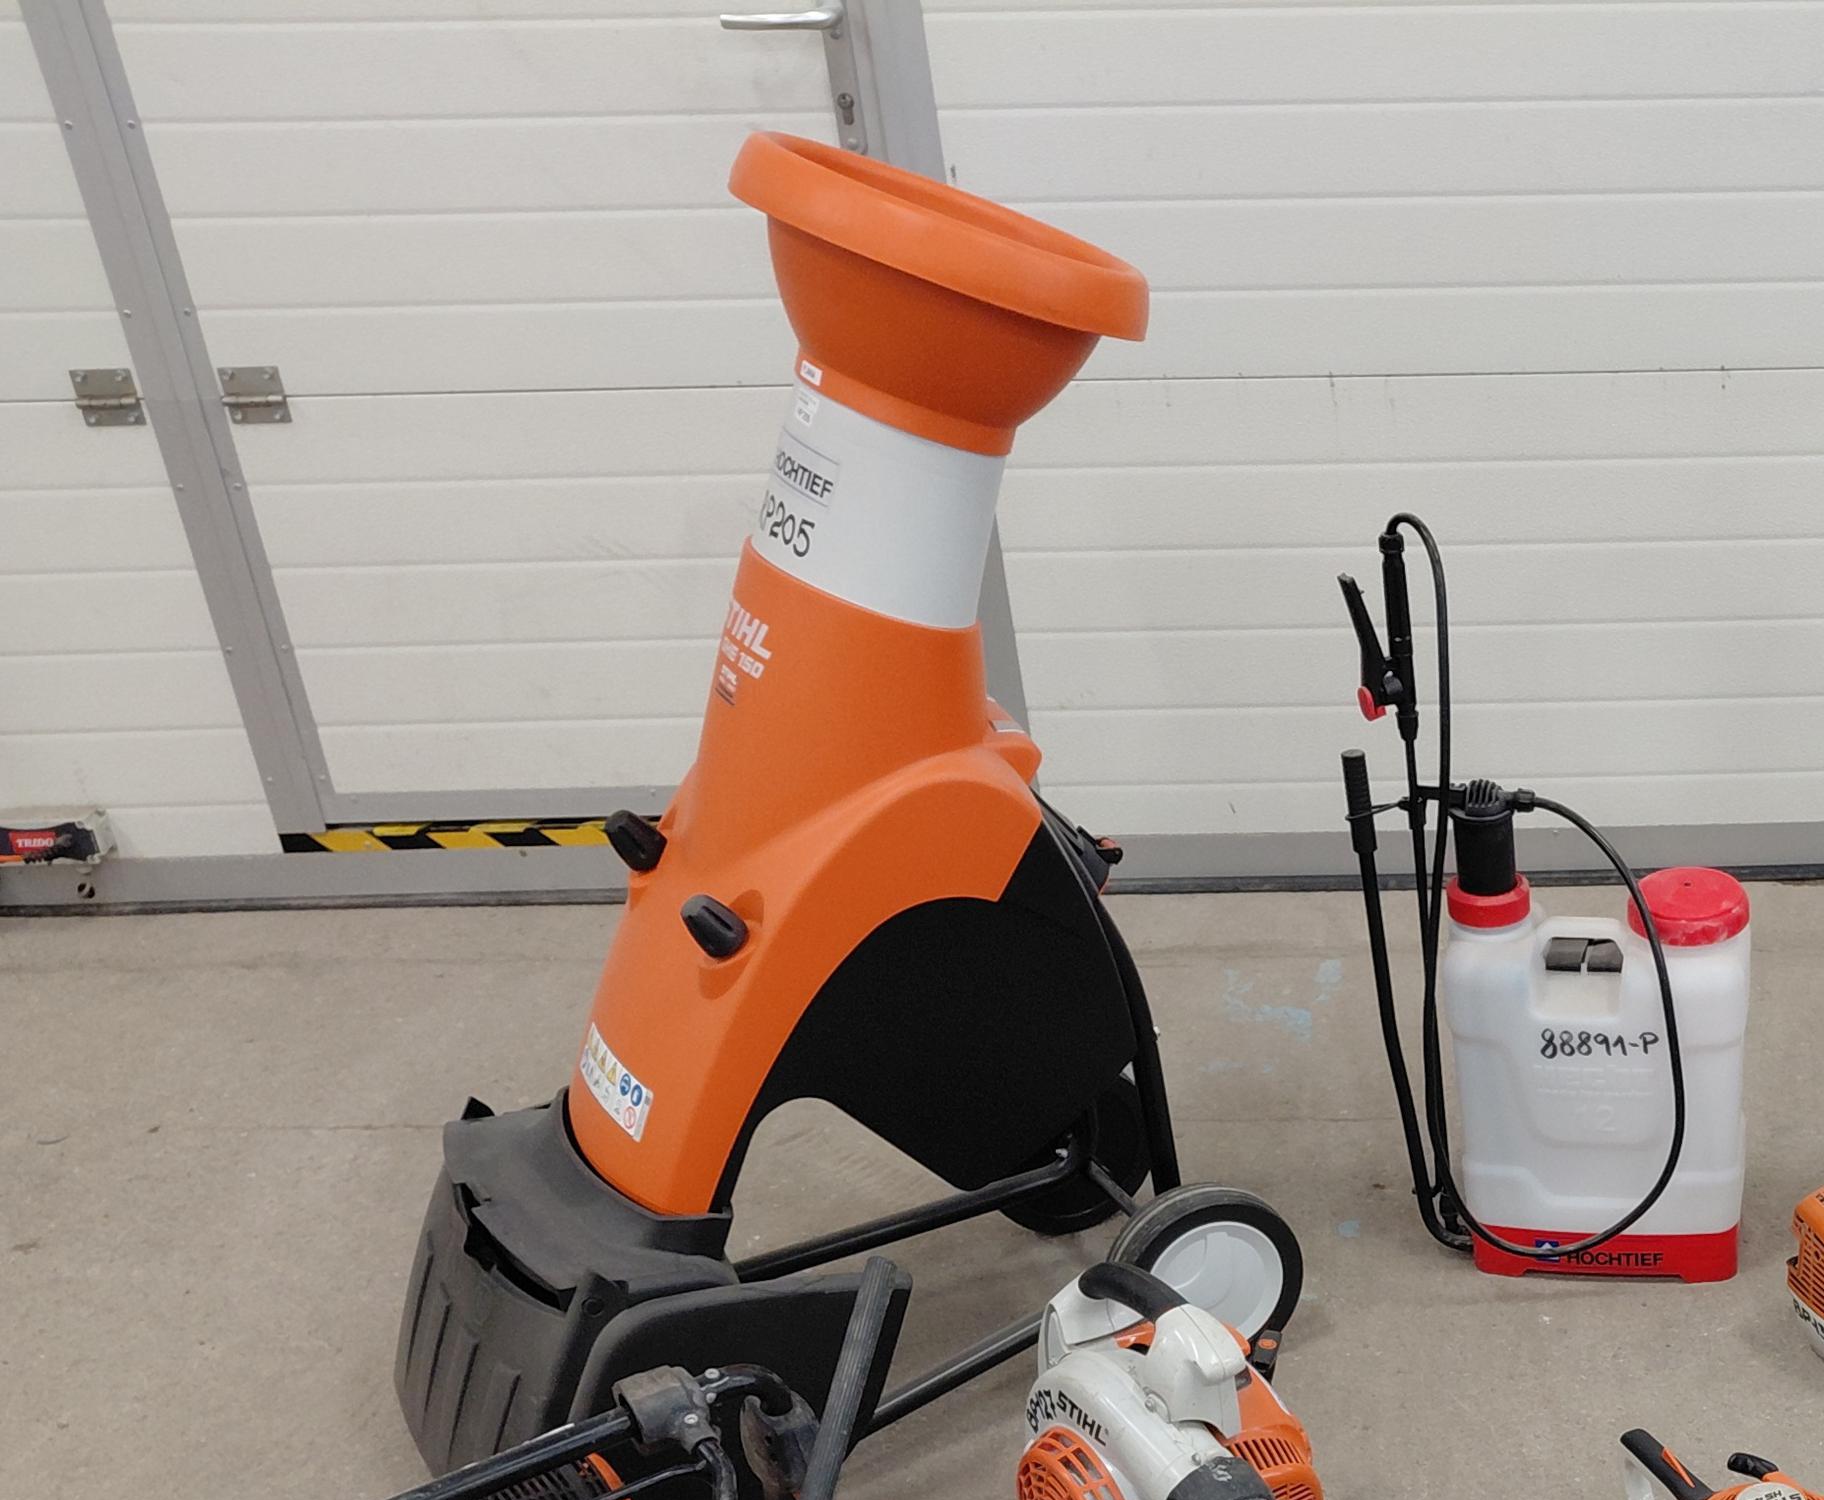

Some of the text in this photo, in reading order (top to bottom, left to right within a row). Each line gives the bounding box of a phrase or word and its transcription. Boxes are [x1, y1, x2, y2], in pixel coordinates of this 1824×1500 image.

[776, 451, 834, 498] OCHTIEF
[727, 601, 772, 660] TIHL
[16, 837, 54, 849] TRIDO
[1540, 1028, 1660, 1059] 88891-P
[1566, 1251, 1664, 1267] HOCHTIEF
[1056, 1390, 1107, 1447] STIHL
